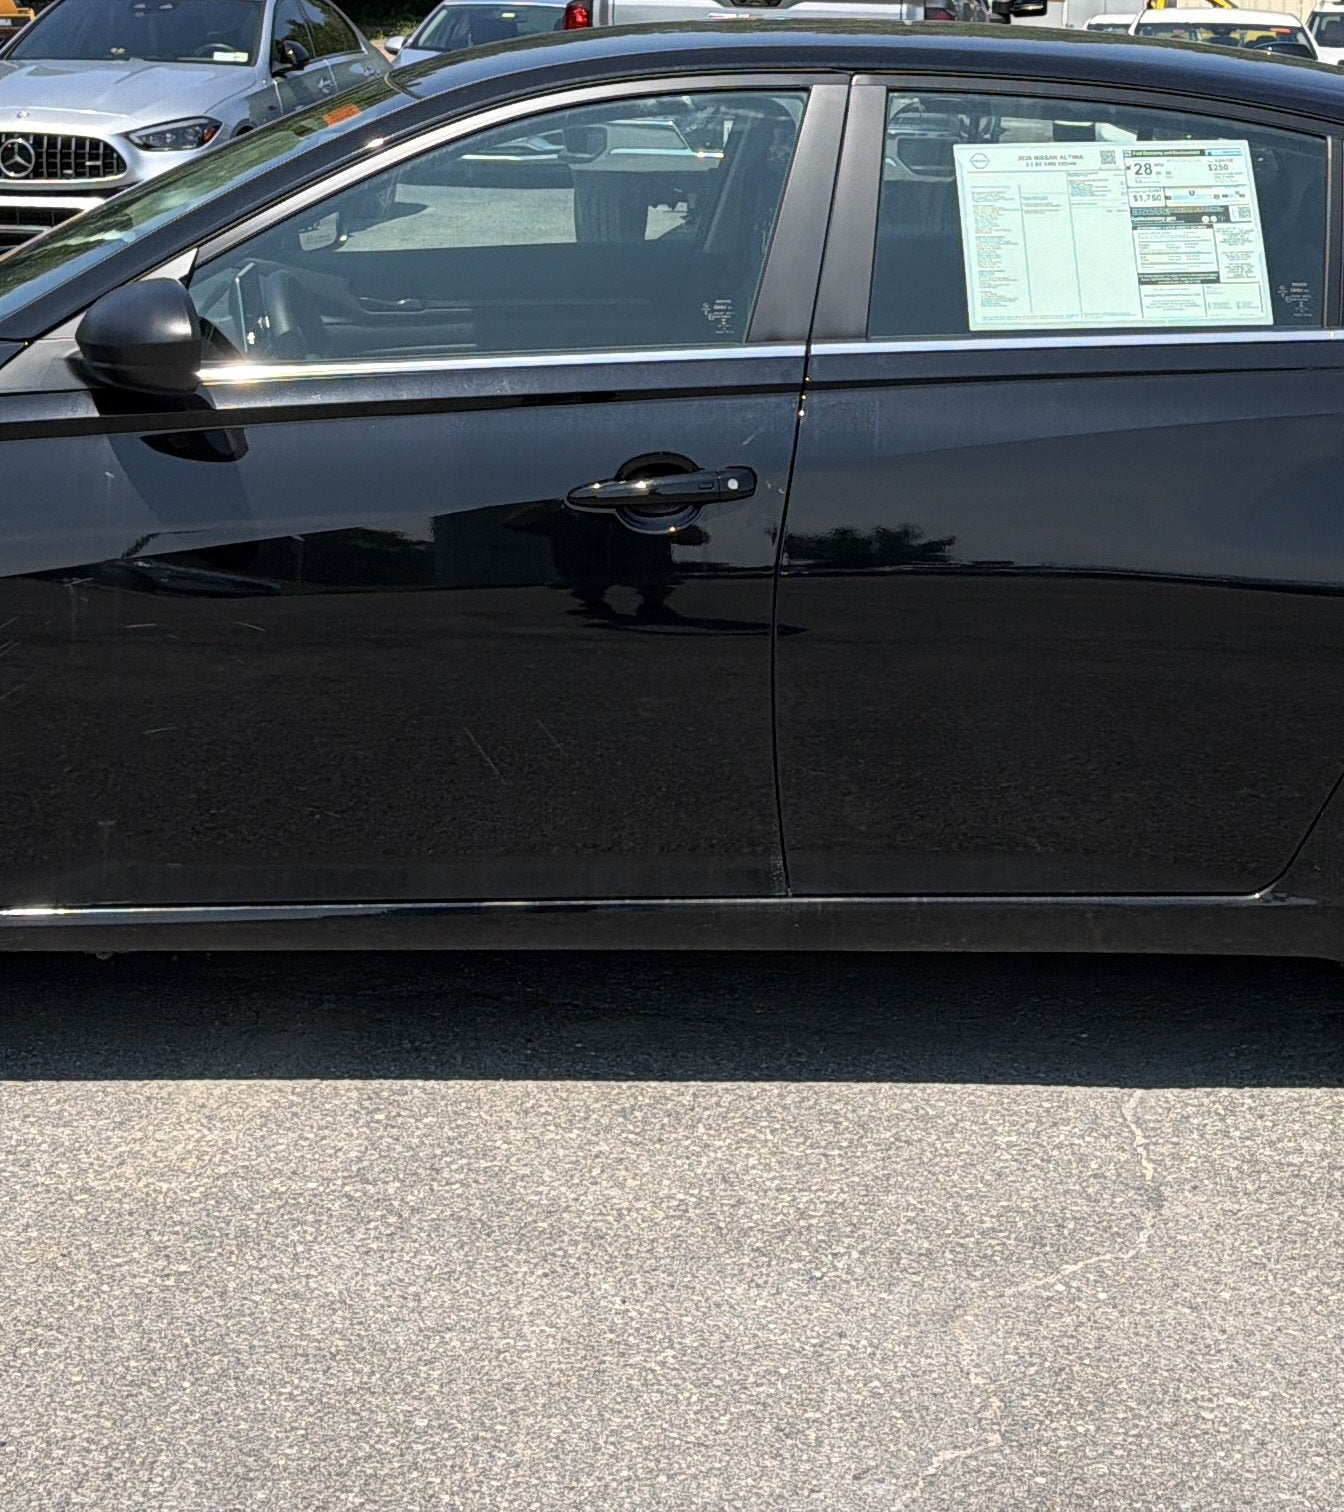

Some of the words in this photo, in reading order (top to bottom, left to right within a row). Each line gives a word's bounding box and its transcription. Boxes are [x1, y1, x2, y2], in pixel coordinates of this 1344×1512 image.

[1133, 162, 1153, 176] 28
[1207, 163, 1229, 172] $250
[1132, 193, 1162, 203] $1,750
